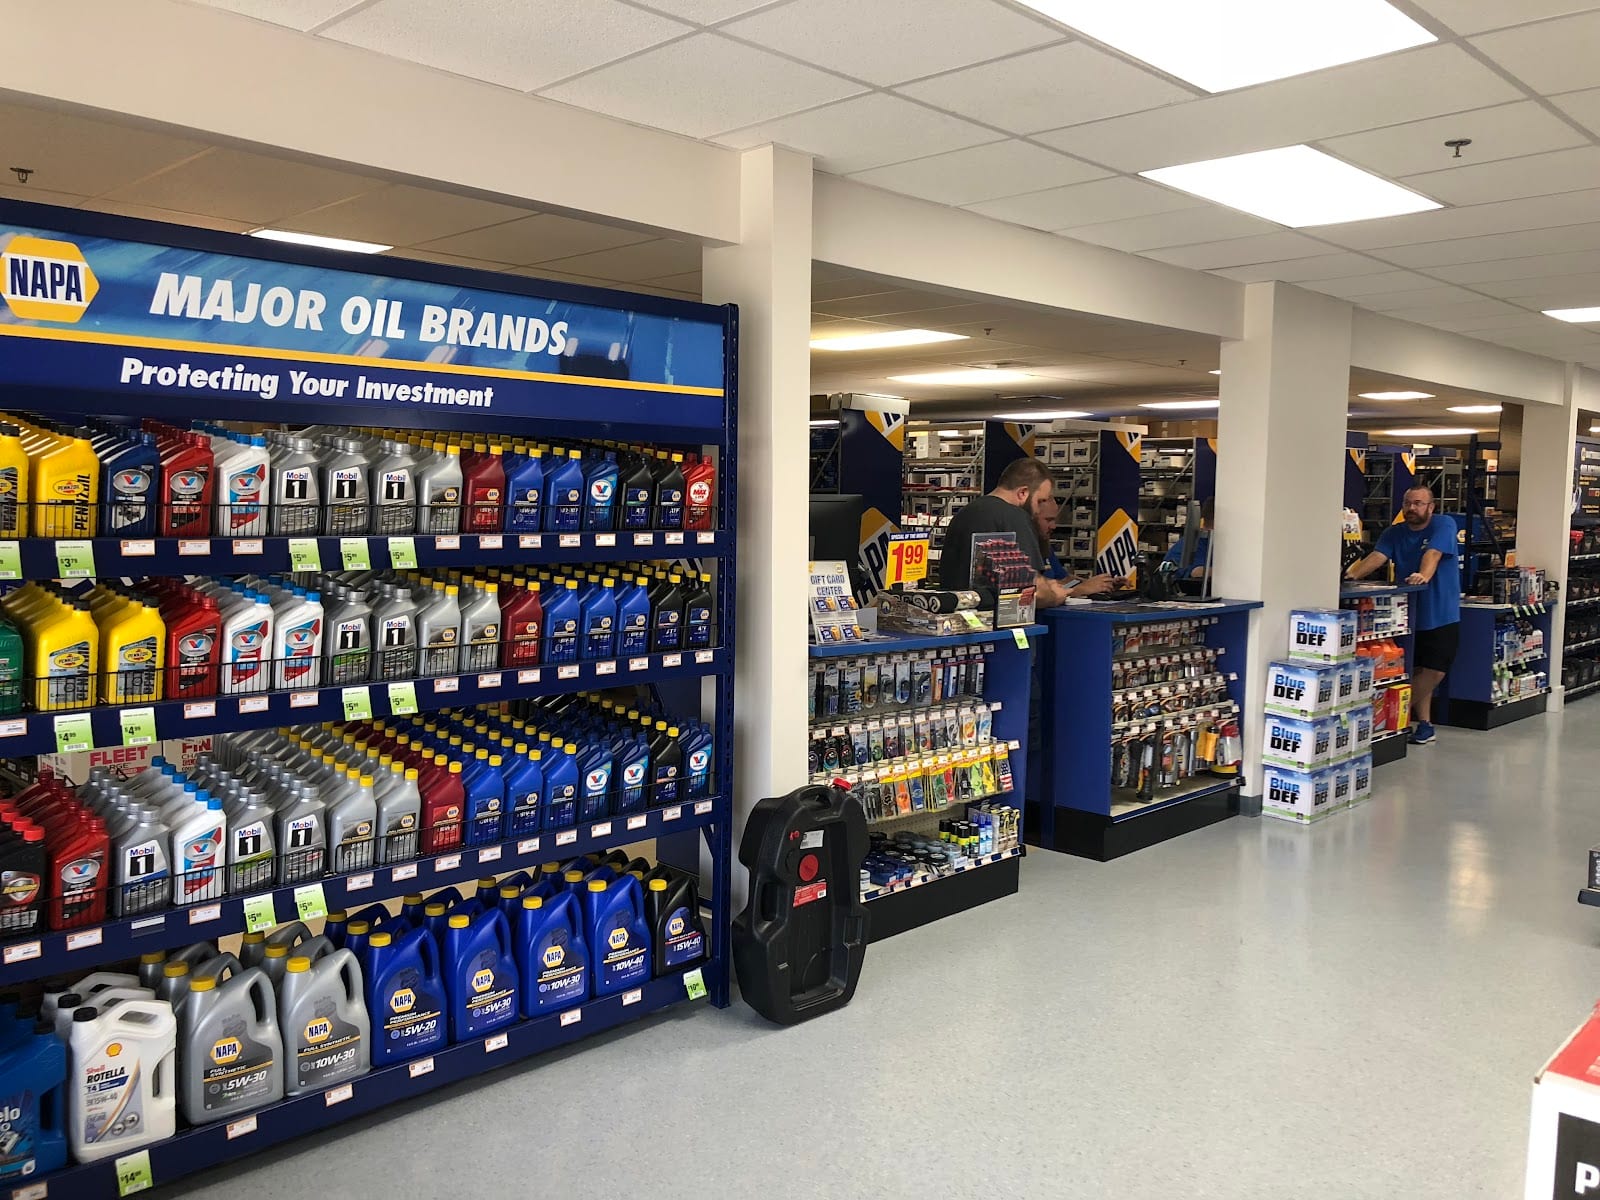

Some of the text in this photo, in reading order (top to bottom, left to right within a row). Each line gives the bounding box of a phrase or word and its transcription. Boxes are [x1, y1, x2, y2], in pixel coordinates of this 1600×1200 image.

[10, 258, 83, 302] NAPA
[149, 272, 568, 356] MAJOR OIL BRANDS
[120, 357, 494, 408] Protecting Your Investment
[286, 472, 309, 480] Mobil
[336, 472, 358, 480] Mobil
[386, 473, 406, 481] Mobil
[292, 481, 300, 498] 1
[342, 481, 350, 498] 1
[391, 482, 399, 499] 1
[811, 574, 845, 584] GIFT CARD
[816, 586, 844, 595] CENTER
[341, 623, 362, 631] Mobil
[386, 620, 407, 628] Mobil
[1297, 621, 1327, 635] Blue
[346, 631, 354, 648] 1
[391, 629, 399, 645] 1
[1296, 632, 1326, 647] DEF
[1275, 674, 1306, 690] Blue
[1273, 685, 1305, 701] DEF
[1272, 726, 1302, 742] Blue
[1270, 736, 1300, 753] DEF
[90, 746, 149, 766] FLEET
[1270, 777, 1300, 794] Blue
[1269, 788, 1299, 804] DEF
[238, 826, 262, 837] Mobil
[291, 820, 314, 829] Mobil
[244, 837, 253, 853] 1
[297, 830, 306, 846] 1
[130, 846, 155, 856] Mobil
[137, 856, 146, 873] 1
[546, 950, 561, 963] NAPA
[551, 974, 581, 990] 10W-30
[394, 994, 412, 1007] NAPA
[308, 1023, 328, 1037] NAPA
[404, 1020, 437, 1037] 5W-20
[216, 1043, 238, 1058] NAPA
[315, 1048, 356, 1068] 10W-30
[87, 1066, 125, 1084] ROTELLA
[227, 1070, 267, 1090] 5W-30
[87, 1085, 97, 1093] T4
